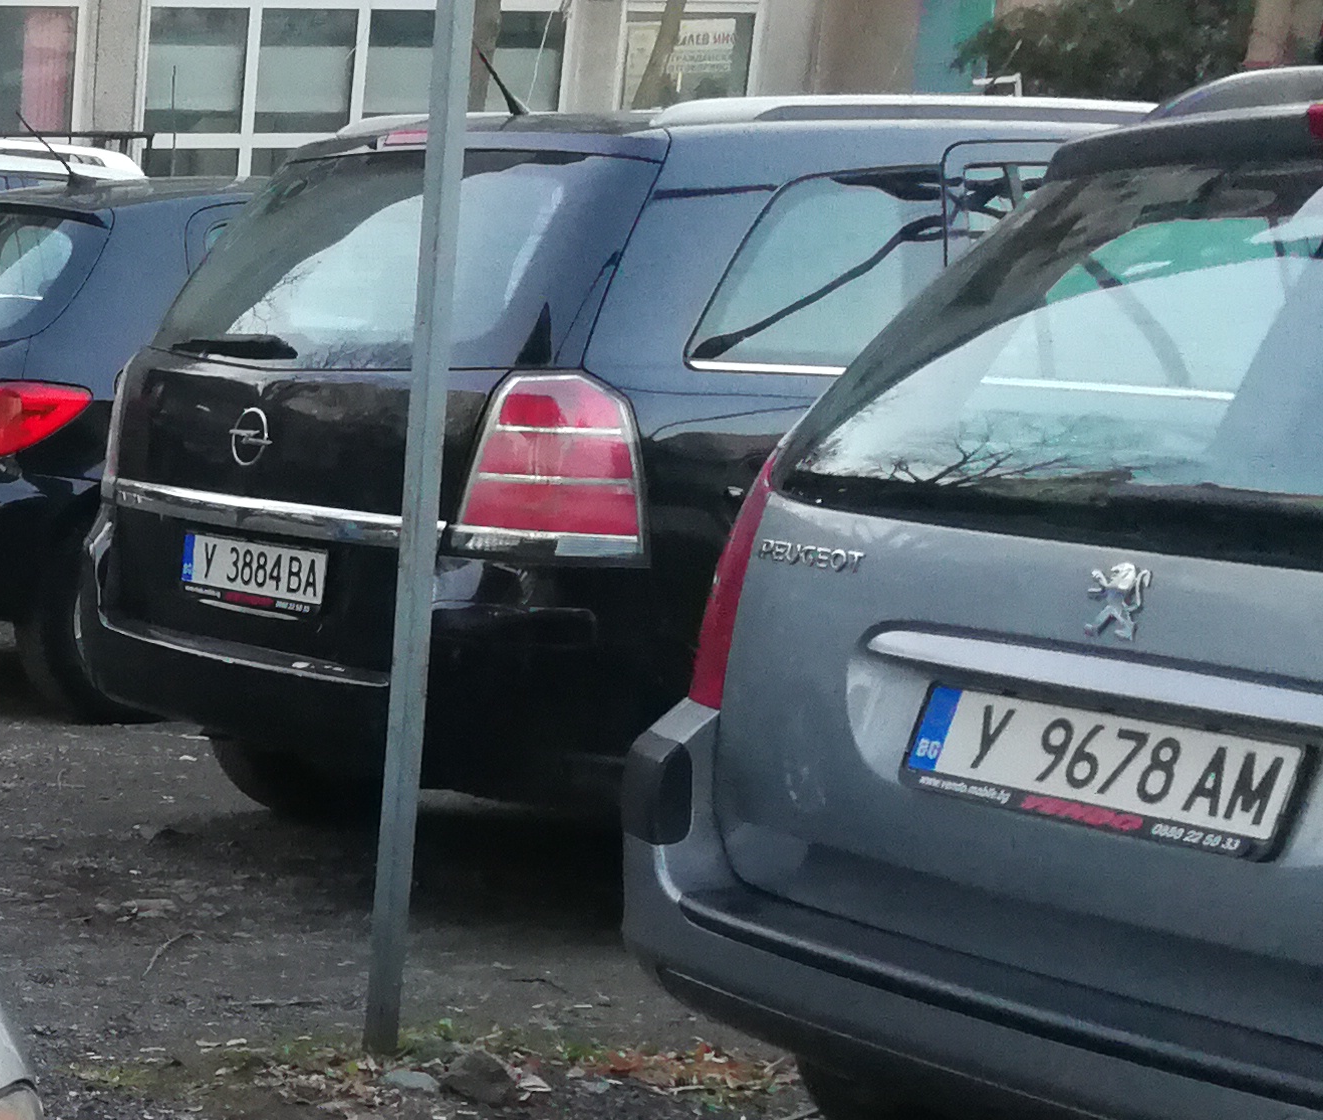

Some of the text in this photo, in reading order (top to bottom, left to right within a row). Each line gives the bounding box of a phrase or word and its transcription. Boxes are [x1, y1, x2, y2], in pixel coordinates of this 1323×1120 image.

[226, 546, 283, 591] 3884
[759, 539, 866, 573] PEUGEOT
[915, 737, 941, 760] BG
[1035, 717, 1181, 804] 9678
